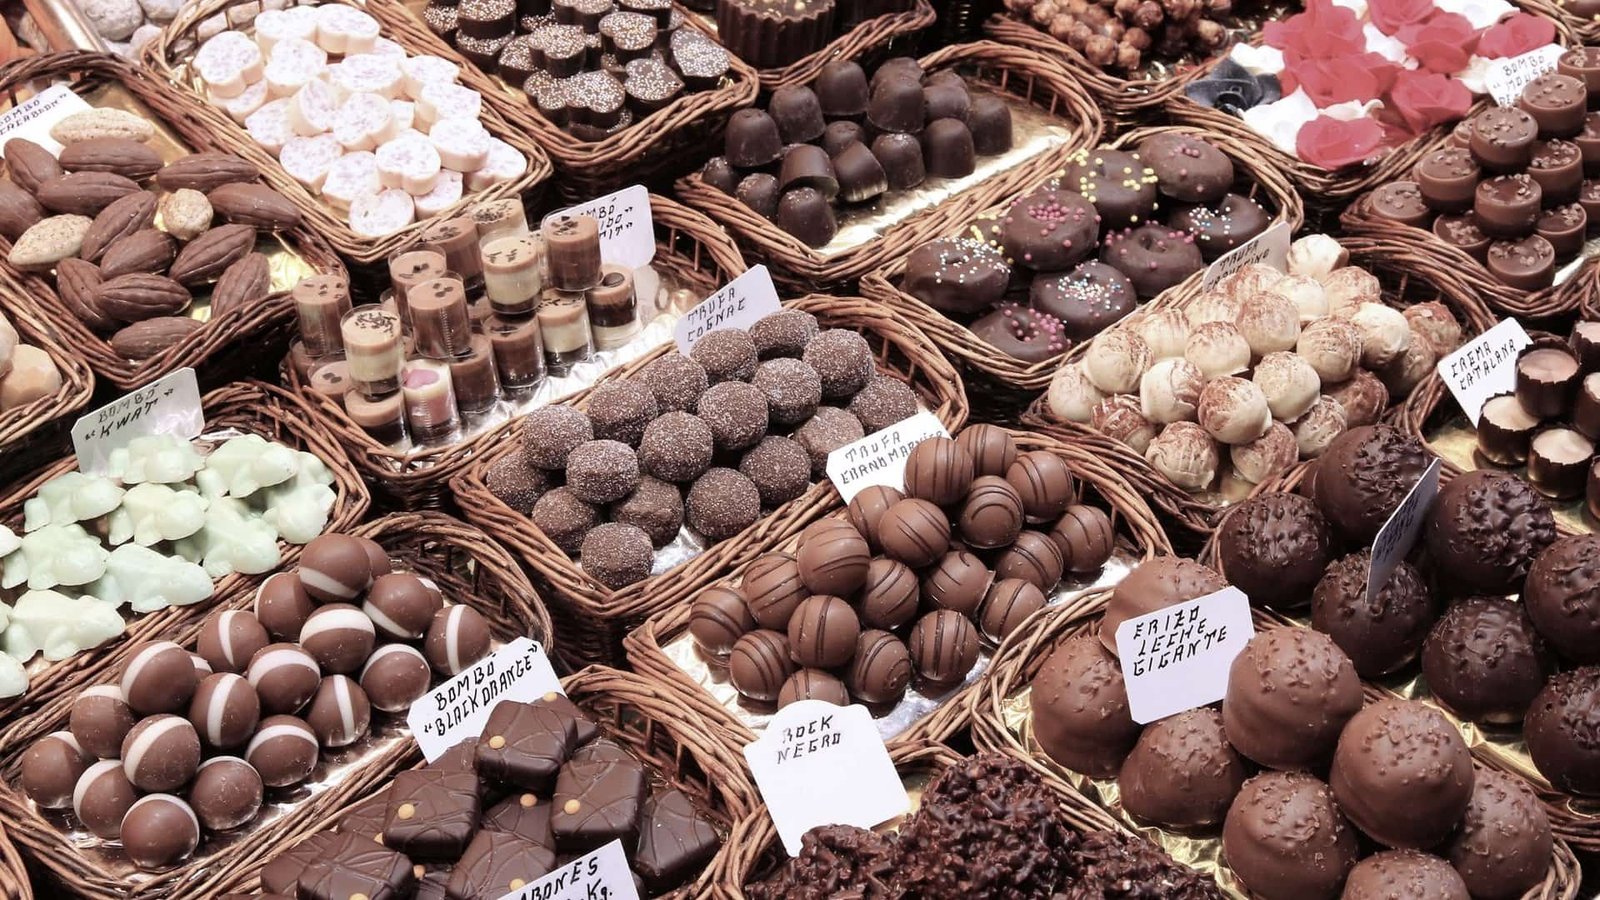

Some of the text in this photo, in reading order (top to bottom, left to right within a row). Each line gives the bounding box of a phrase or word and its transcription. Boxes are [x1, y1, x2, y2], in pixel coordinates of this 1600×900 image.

[1220, 239, 1259, 271] TRUFA
[687, 287, 735, 324] TRUFA
[687, 297, 746, 342] COGNAC
[1451, 341, 1492, 378] CREMA
[1459, 339, 1517, 391] CATALANA
[845, 431, 901, 463] TRUFA
[1133, 605, 1200, 640] ERIZO
[1138, 618, 1207, 657] LECHE
[1133, 625, 1227, 677] GIGANTE
[434, 652, 497, 711] BOMBÓ
[782, 714, 834, 744] ROCK
[776, 732, 841, 765] NEGRO
